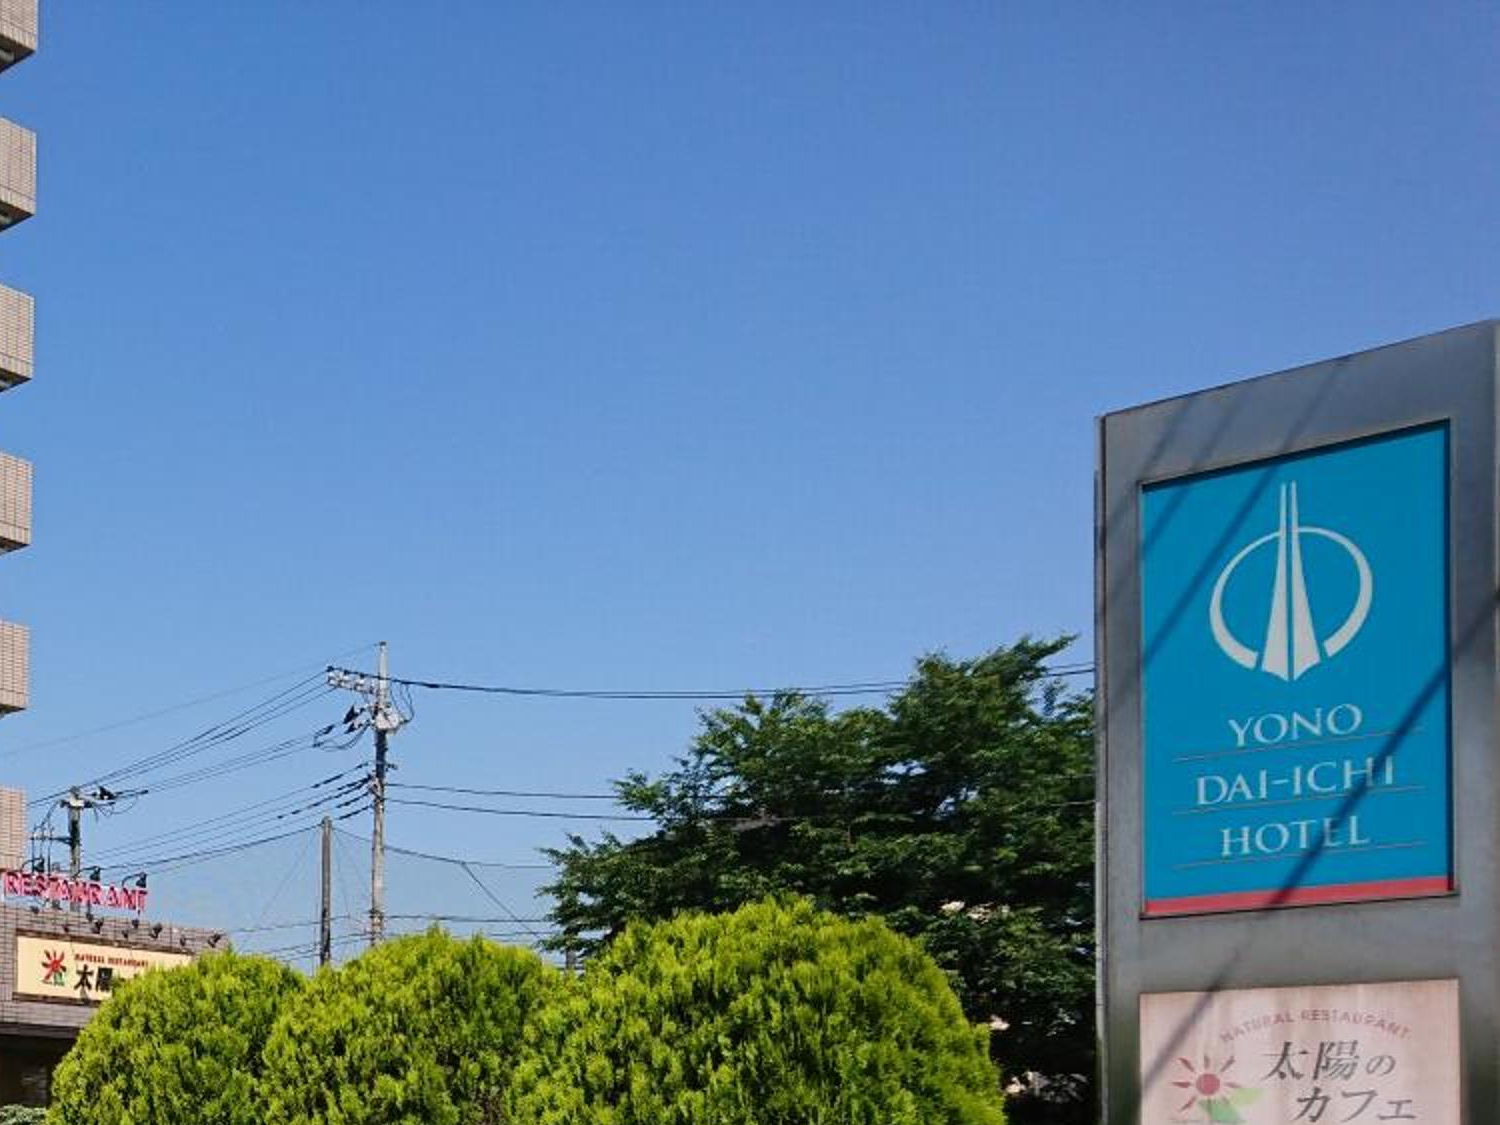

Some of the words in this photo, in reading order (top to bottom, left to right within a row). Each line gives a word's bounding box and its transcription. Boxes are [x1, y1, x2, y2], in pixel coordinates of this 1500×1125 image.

[1229, 704, 1362, 747] YONO
[1198, 755, 1395, 805] DAI-ICHI
[1220, 815, 1370, 857] HOTEL
[3, 870, 149, 911] RESTAURANT
[1220, 1009, 1295, 1043] NATURAL
[1299, 1008, 1413, 1040] RESTAURANT
[1260, 1039, 1397, 1081] 太陽の
[1292, 1086, 1417, 1124] カフェ
